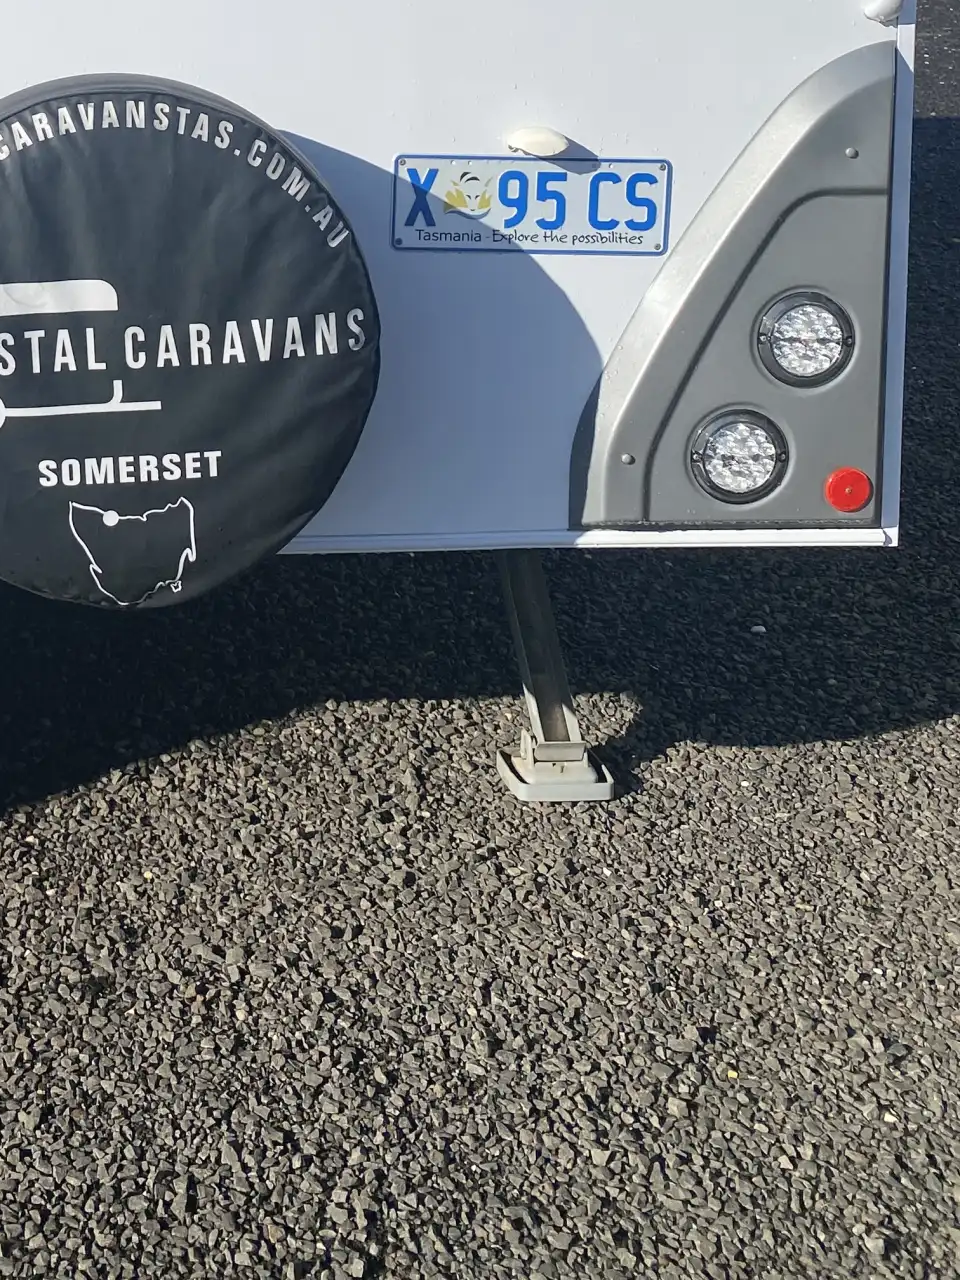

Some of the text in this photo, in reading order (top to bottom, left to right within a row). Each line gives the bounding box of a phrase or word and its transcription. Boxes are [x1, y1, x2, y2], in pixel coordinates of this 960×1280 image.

[404, 168, 659, 231] X 95 CS
[415, 229, 482, 243] Tasmania
[492, 230, 540, 245] Explore
[543, 230, 568, 244] the
[572, 231, 644, 246] possibilities
[124, 308, 366, 370] CARAVANS
[38, 450, 222, 487] SOMERSET
